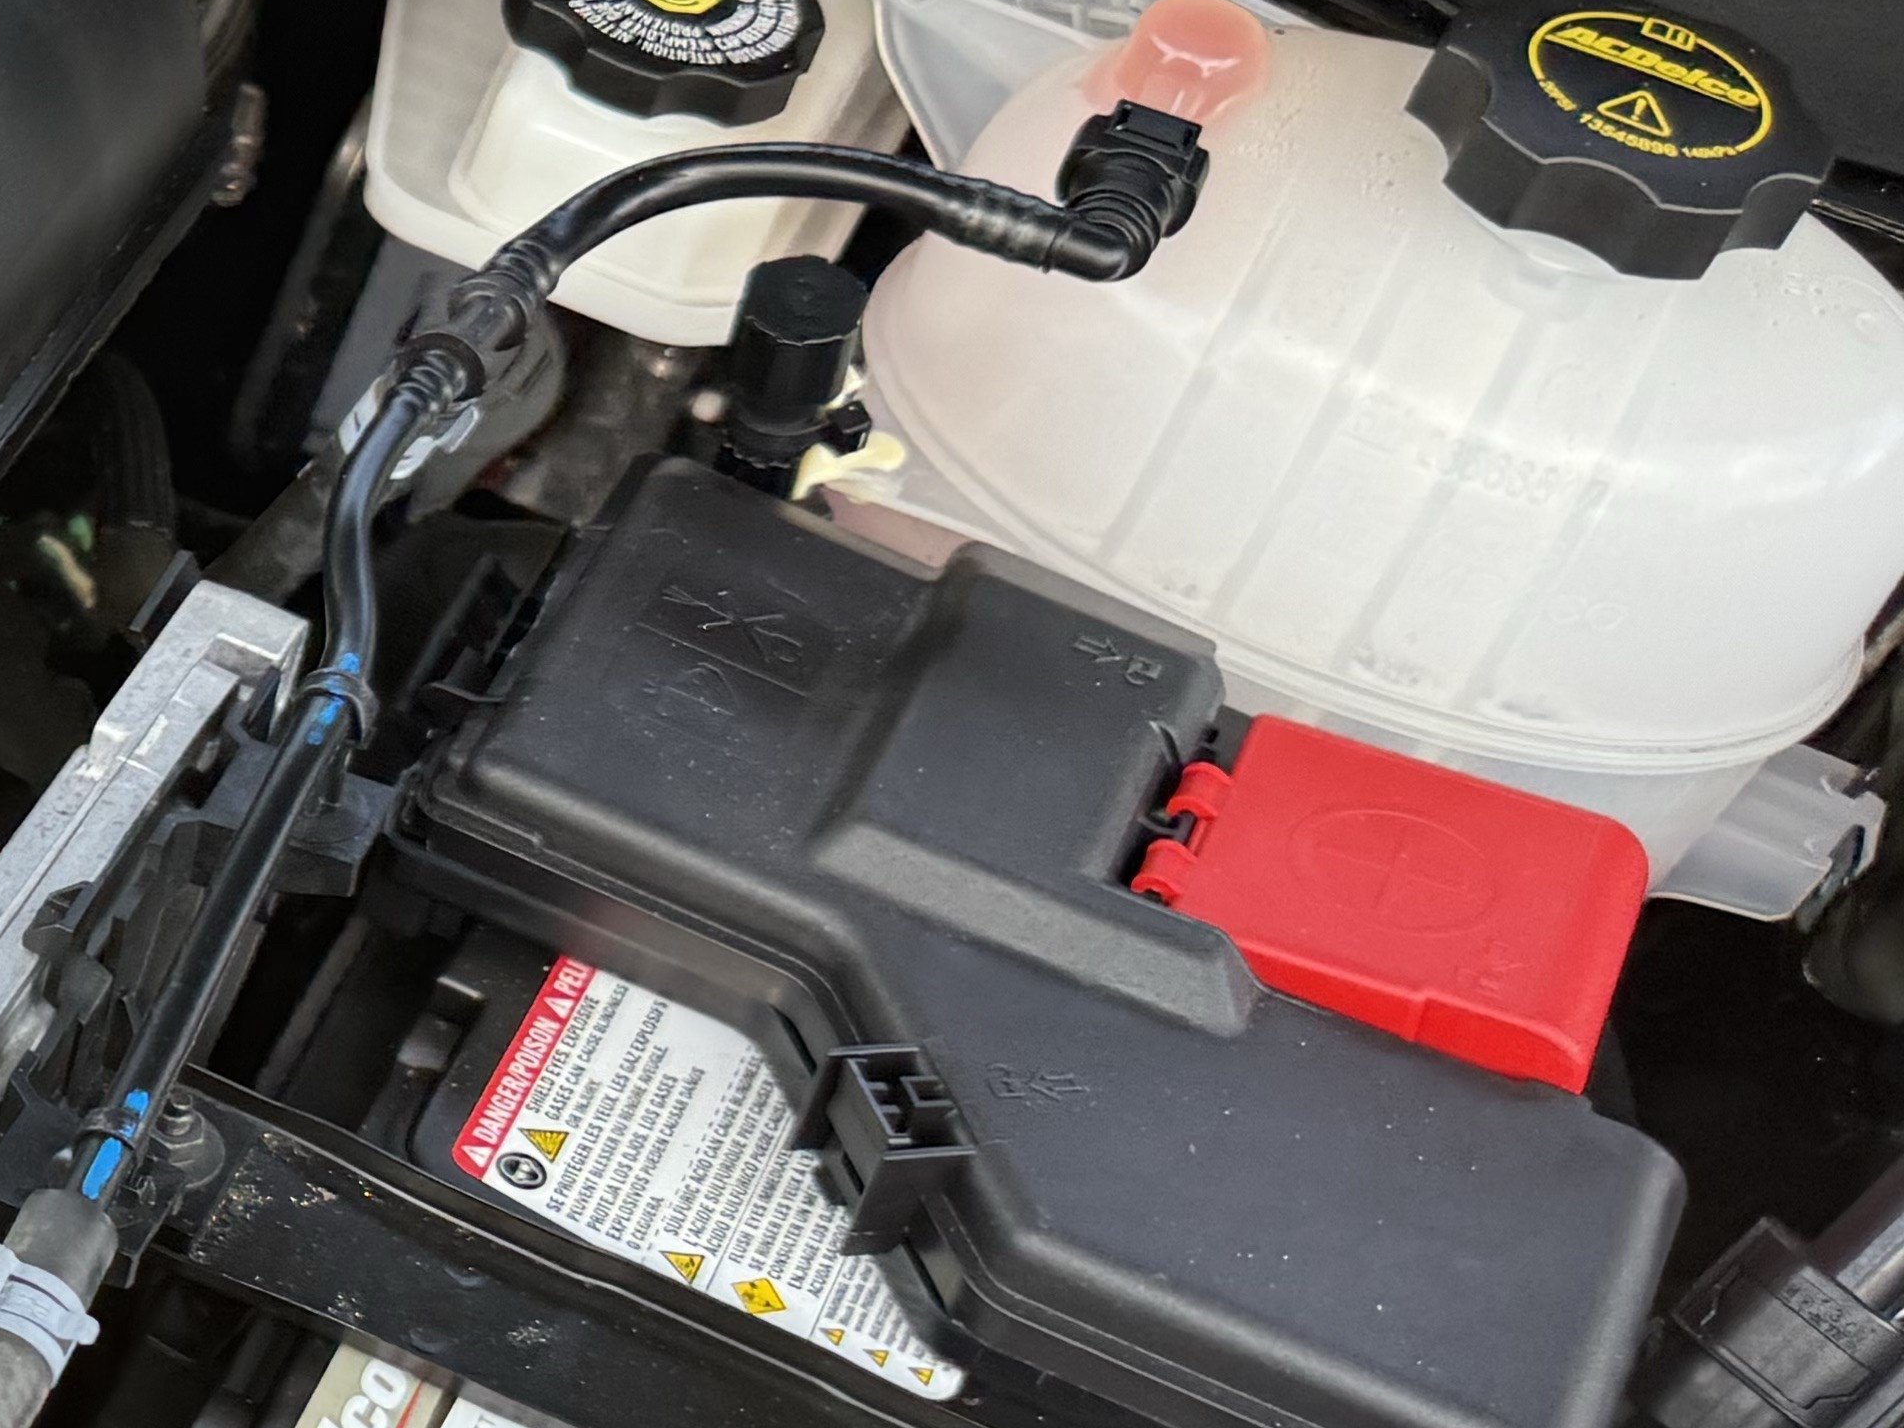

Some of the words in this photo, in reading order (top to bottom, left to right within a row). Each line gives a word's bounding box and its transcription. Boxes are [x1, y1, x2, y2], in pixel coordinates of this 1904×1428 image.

[1555, 26, 1761, 108] ACDelco
[473, 1014, 559, 1145] DANGER/POISON
[544, 1083, 574, 1121] GASES
[580, 1120, 602, 1144] LES
[610, 1160, 632, 1185] LOS
[637, 1105, 661, 1131] LOS
[649, 1071, 679, 1109] GASES
